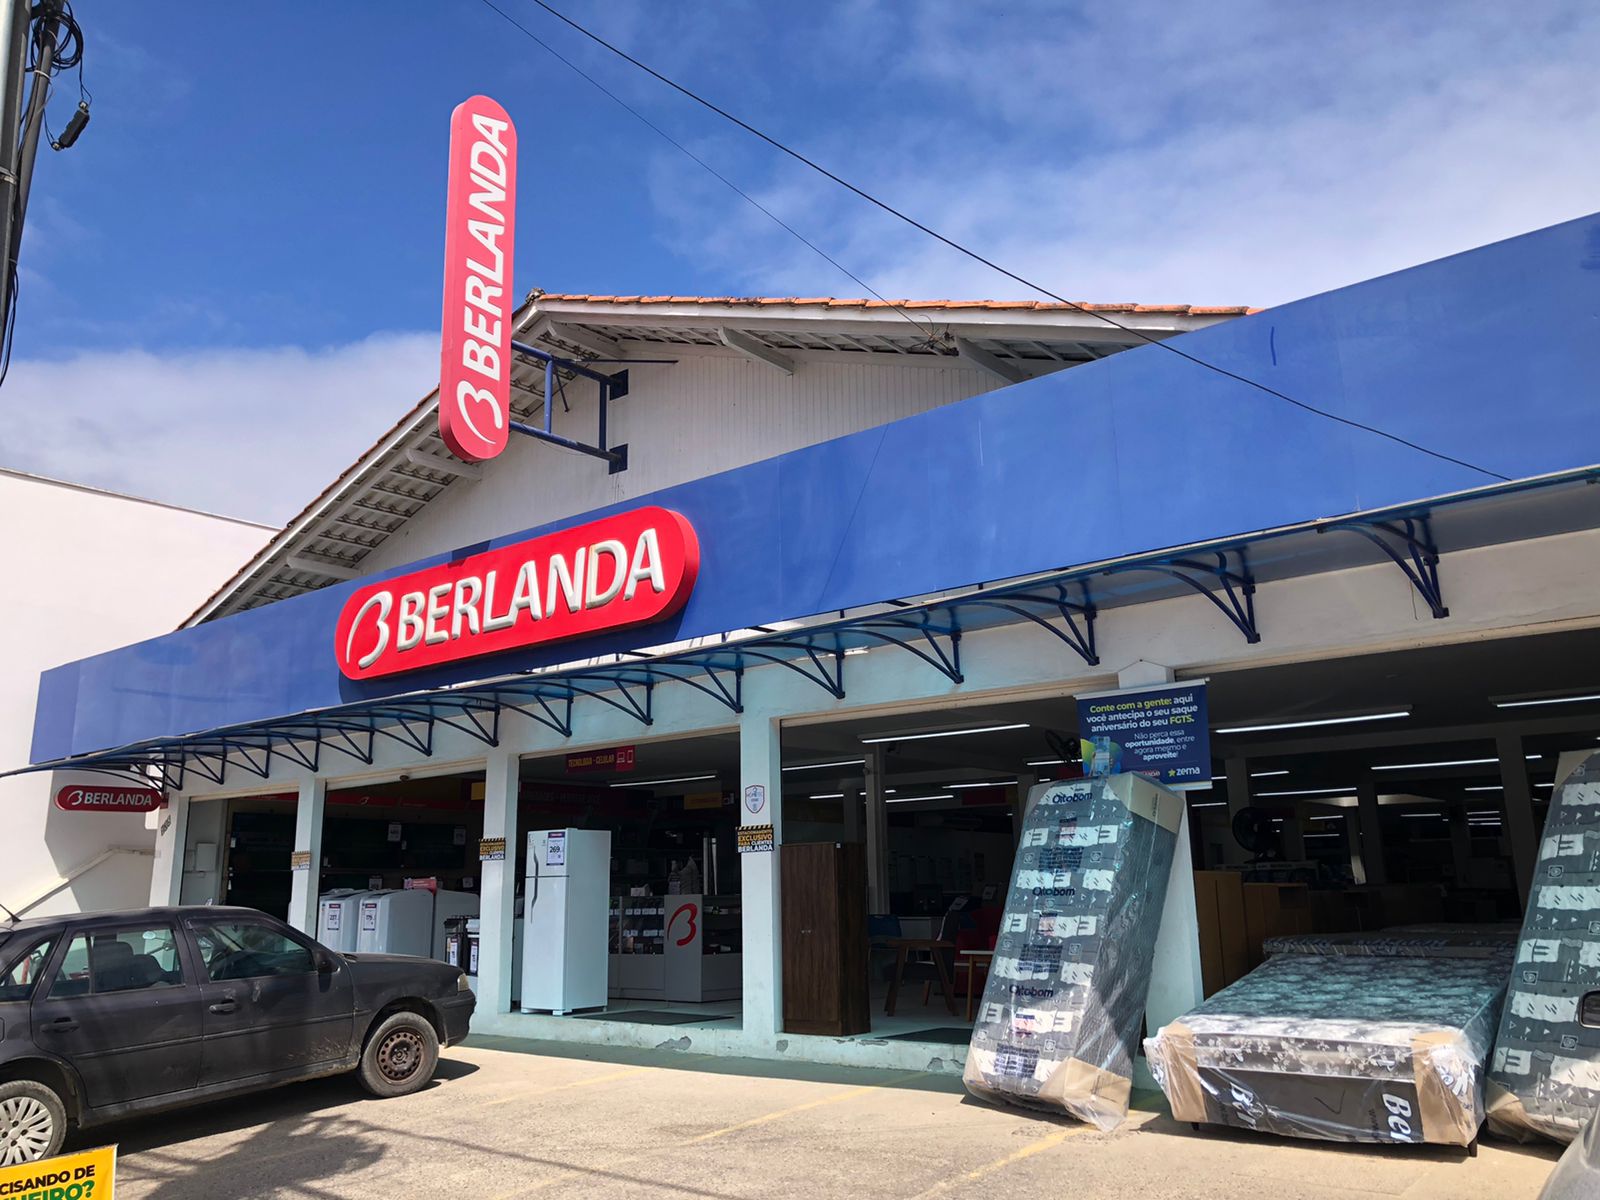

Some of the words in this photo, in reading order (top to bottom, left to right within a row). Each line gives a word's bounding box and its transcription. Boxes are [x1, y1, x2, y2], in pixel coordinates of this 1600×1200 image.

[462, 113, 509, 382] BERLANDA
[396, 528, 665, 653] BERLANDA
[1090, 704, 1115, 713] Conte
[1117, 702, 1136, 711] com
[1144, 698, 1172, 709] gente:
[1173, 693, 1193, 705] aqui
[1086, 714, 1107, 724] você
[1108, 710, 1145, 721] antecipa
[1154, 708, 1170, 716] seu
[1171, 705, 1198, 716] saque
[1091, 720, 1138, 732] aniversário
[1139, 719, 1151, 728] do
[1152, 718, 1168, 727] seu
[1169, 715, 1195, 724] FGTS.
[1134, 732, 1149, 740] Não
[1149, 731, 1169, 739] perca
[1169, 729, 1185, 737] essa
[1176, 735, 1195, 743] entre
[1134, 747, 1154, 755] agora
[1154, 744, 1181, 752] mesmo
[1176, 766, 1200, 777] zema
[84, 792, 152, 806] BERLANDA
[74, 1165, 95, 1180] DE
